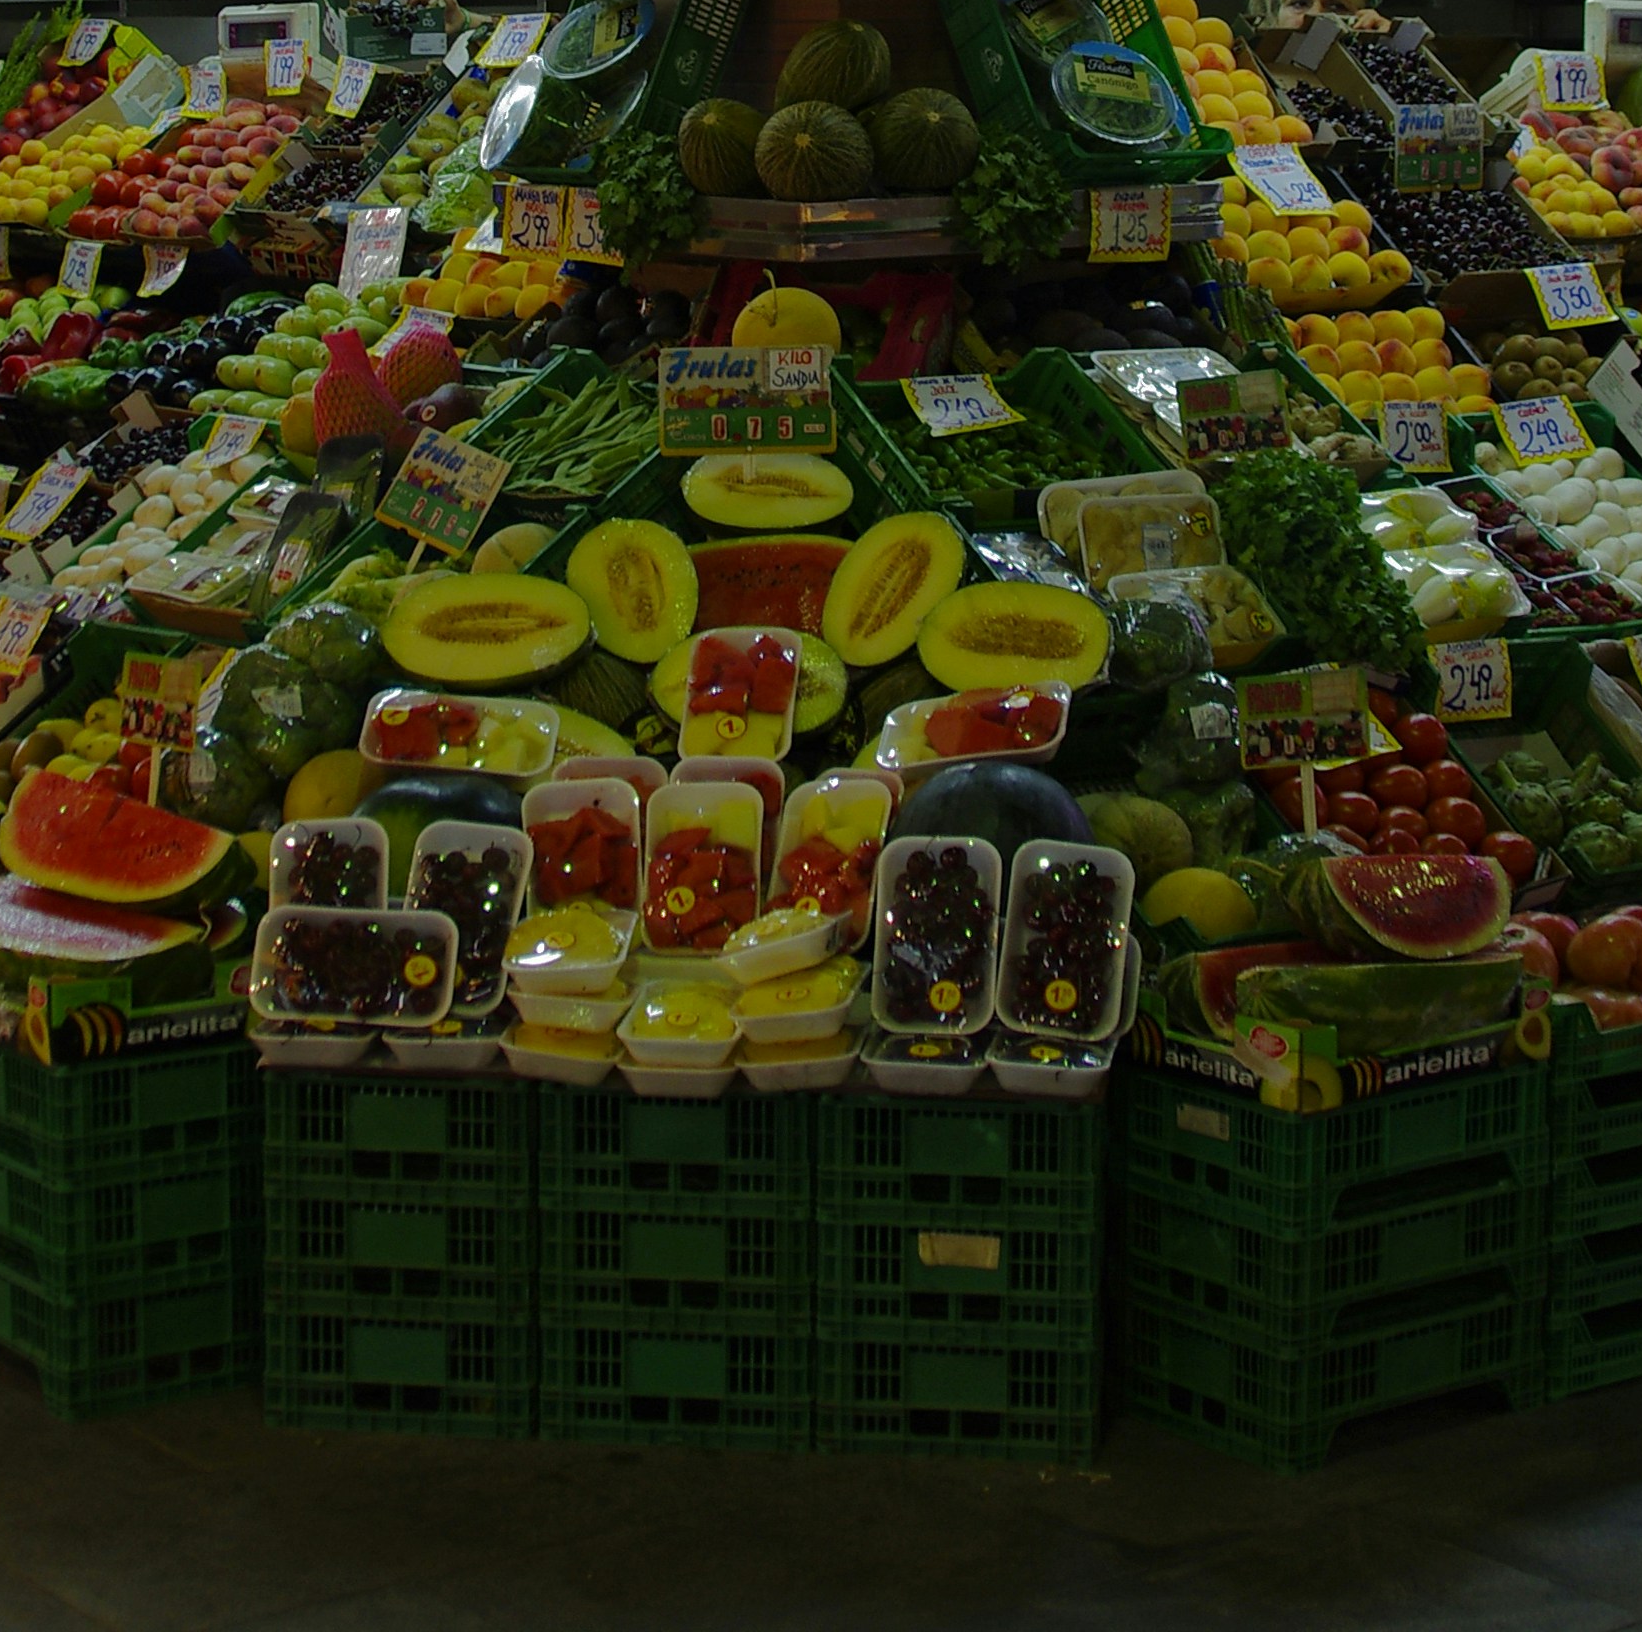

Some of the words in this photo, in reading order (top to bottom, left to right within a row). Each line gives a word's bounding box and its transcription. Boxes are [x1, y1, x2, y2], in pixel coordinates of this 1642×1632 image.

[1398, 108, 1445, 134] Frutas
[665, 354, 759, 388] Frutas
[776, 350, 813, 368] KILO
[127, 1010, 243, 1046] arielita
[1164, 1048, 1255, 1089] arielita
[1384, 1039, 1496, 1085] arielita
